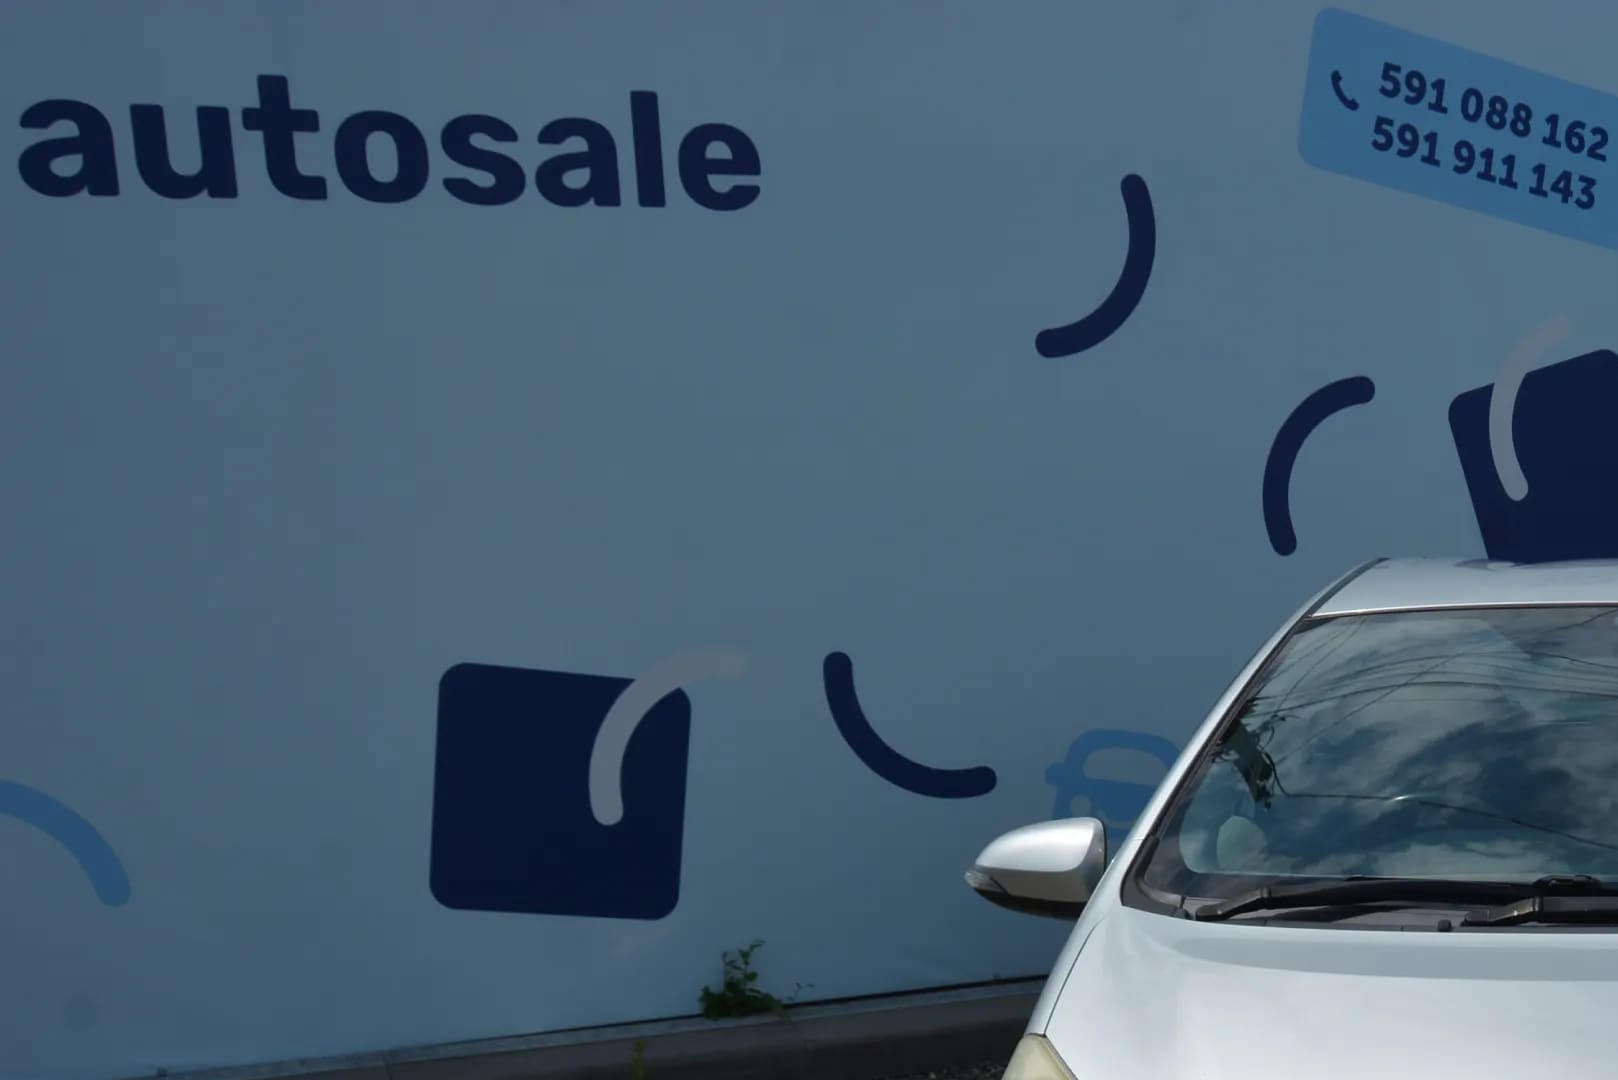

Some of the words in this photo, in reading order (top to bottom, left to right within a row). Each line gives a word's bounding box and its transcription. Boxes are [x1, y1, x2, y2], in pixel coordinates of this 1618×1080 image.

[17, 73, 762, 212] autosale
[1378, 61, 1448, 114] 591
[1460, 87, 1532, 138] 088
[1541, 113, 1609, 162] 162
[1371, 115, 1441, 167] 591
[1452, 140, 1518, 190] 911
[1528, 163, 1597, 210] 143
